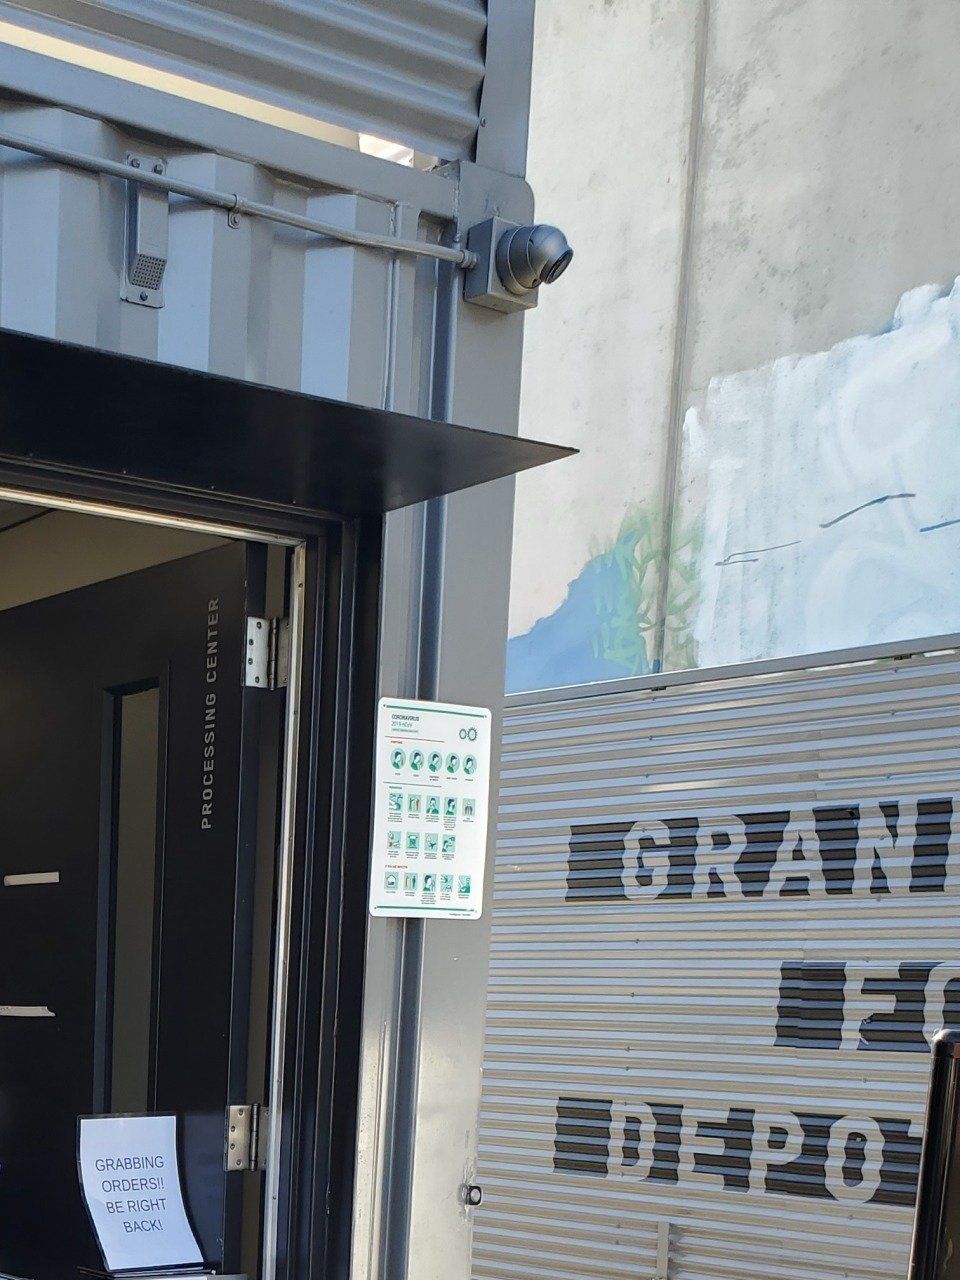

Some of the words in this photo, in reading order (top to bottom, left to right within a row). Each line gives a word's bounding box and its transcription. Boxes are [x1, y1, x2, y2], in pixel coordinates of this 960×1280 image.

[205, 598, 220, 684] CENTER
[201, 692, 217, 830] PROCESSING
[621, 797, 960, 901] GRAN
[95, 1155, 165, 1172] GRABBING
[606, 1098, 924, 1205] DEPO
[101, 1177, 165, 1193] ORDERS!!
[106, 1200, 124, 1215] BE
[127, 1198, 167, 1213] RIGHT
[123, 1219, 164, 1234] BACK!
